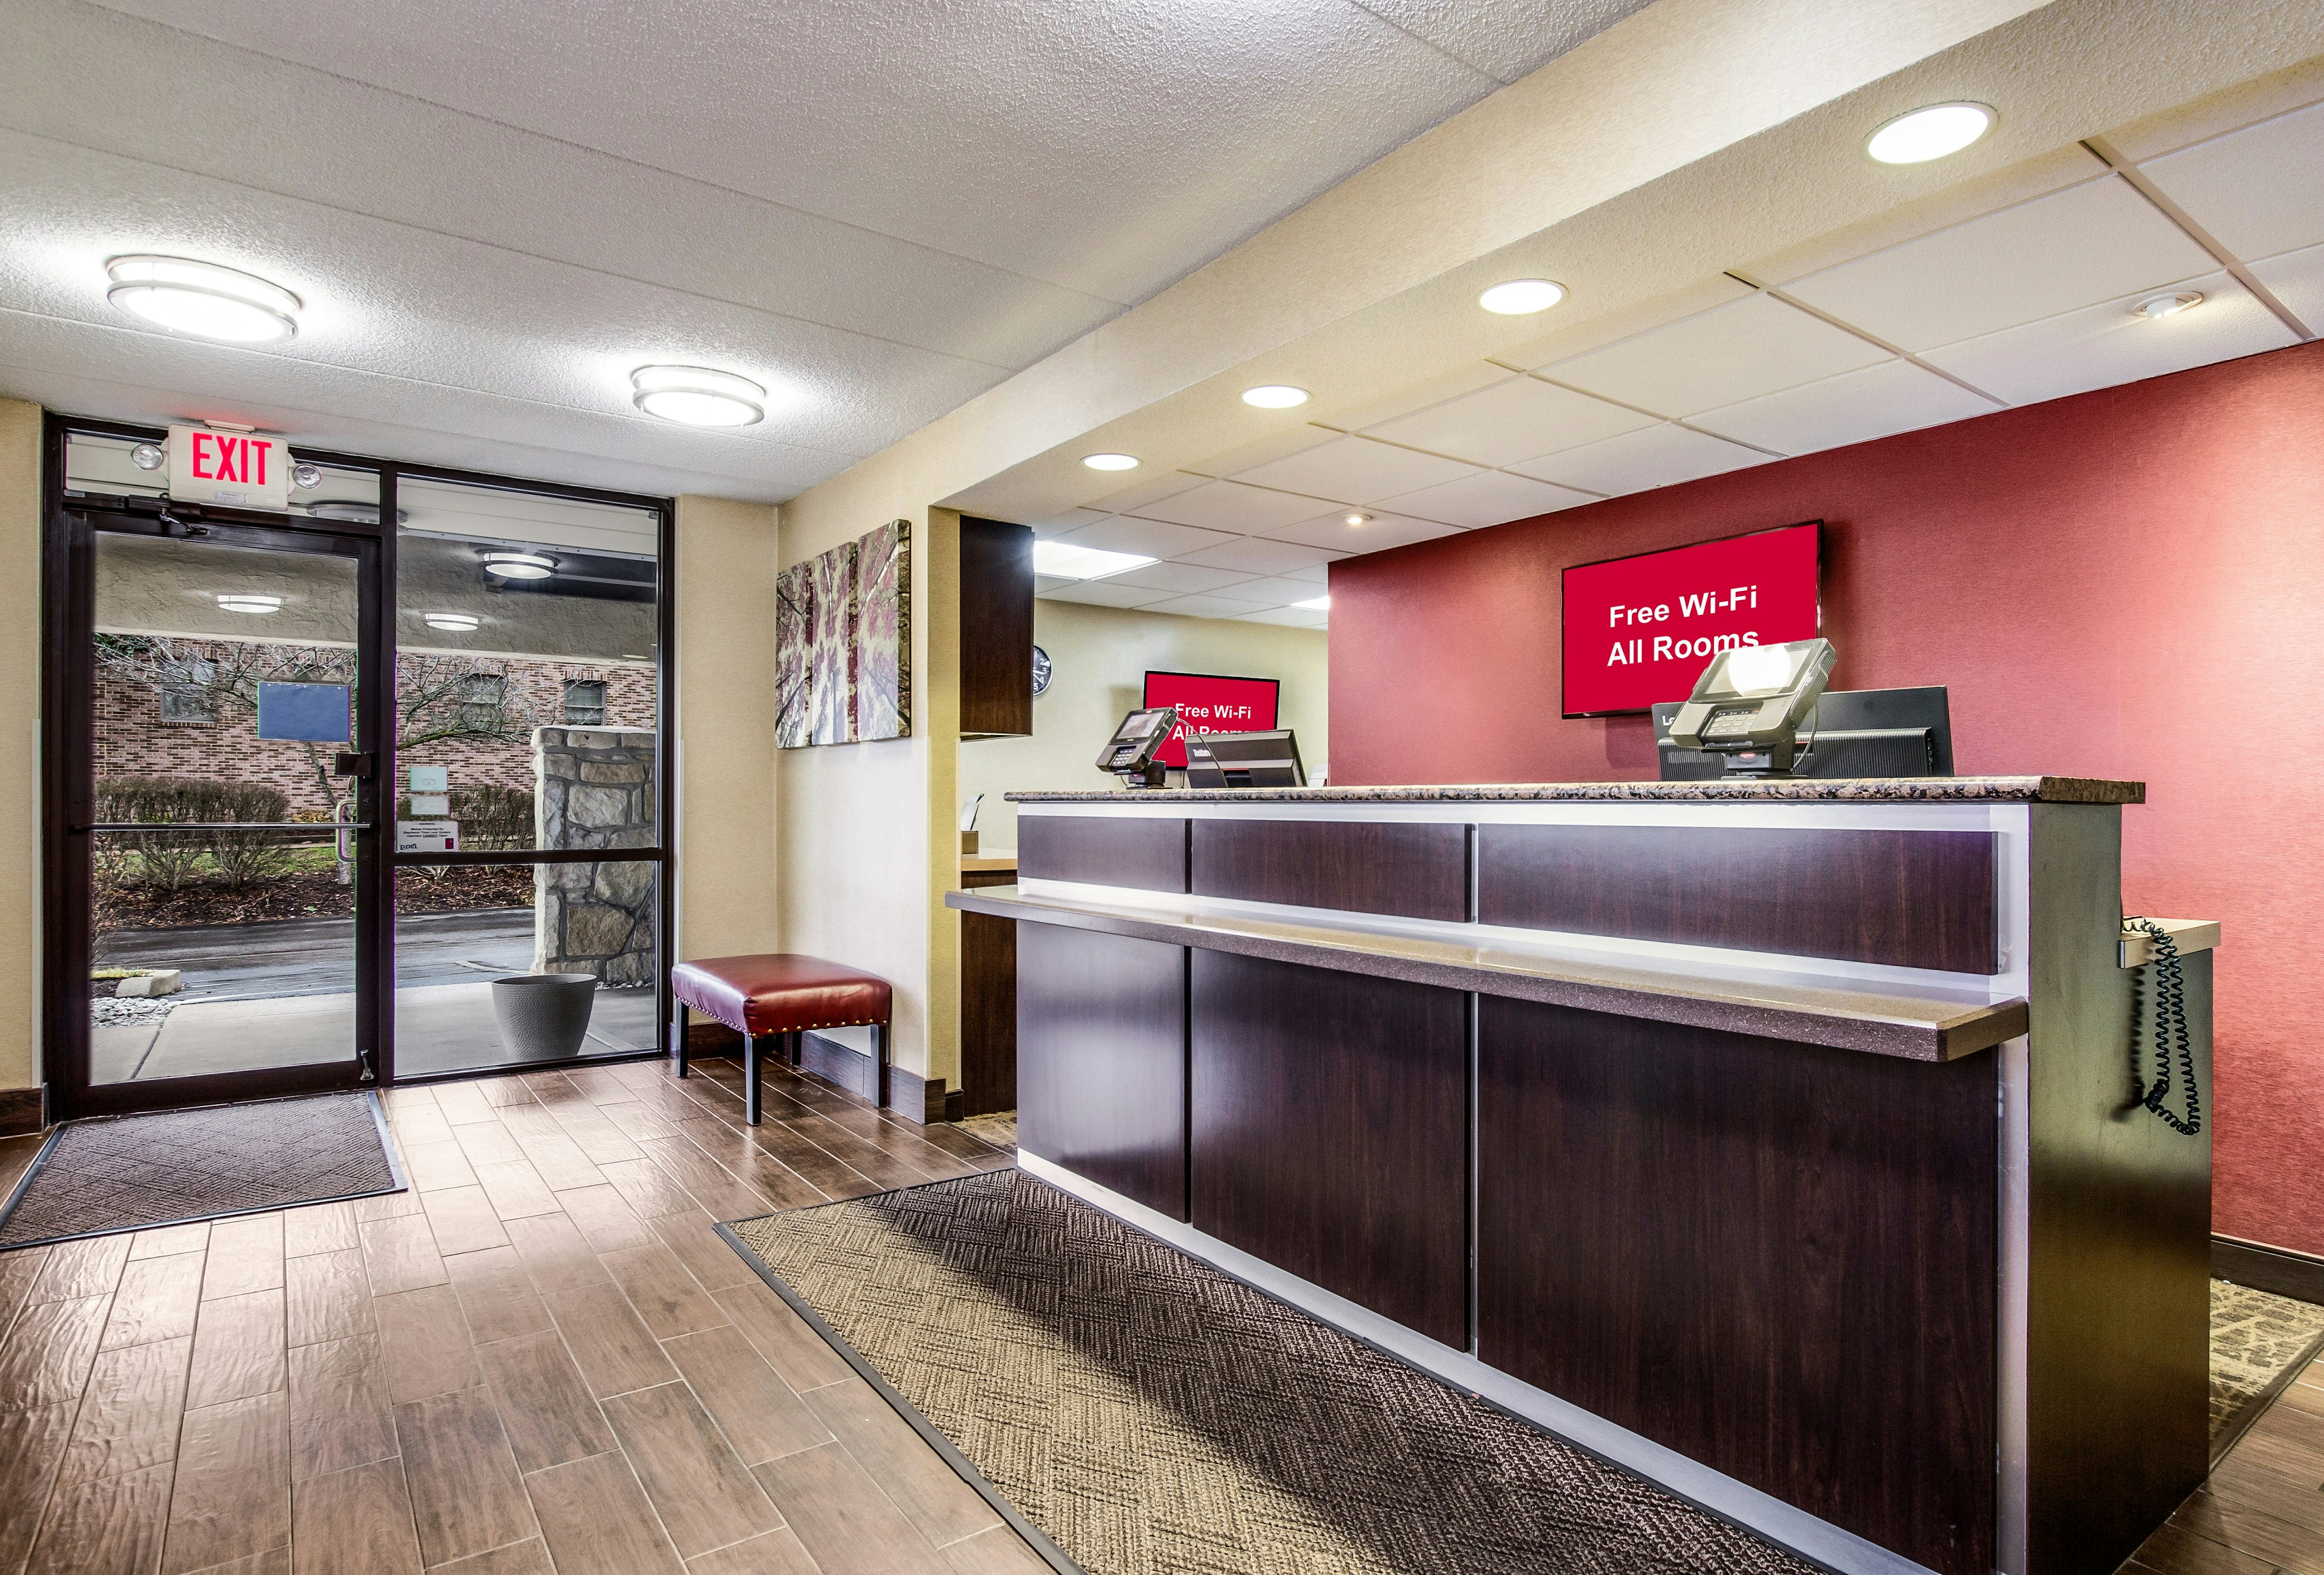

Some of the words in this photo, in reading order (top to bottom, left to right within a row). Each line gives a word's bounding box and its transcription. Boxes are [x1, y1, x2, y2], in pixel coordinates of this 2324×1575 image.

[193, 432, 272, 485] EXIT
[1610, 604, 1670, 628] Free
[1678, 585, 1756, 618] Wi-Fi
[1607, 638, 1642, 666] All
[1654, 631, 1759, 661] Rooms
[1175, 703, 1209, 718] Free
[1214, 705, 1251, 719] Wi-Fi
